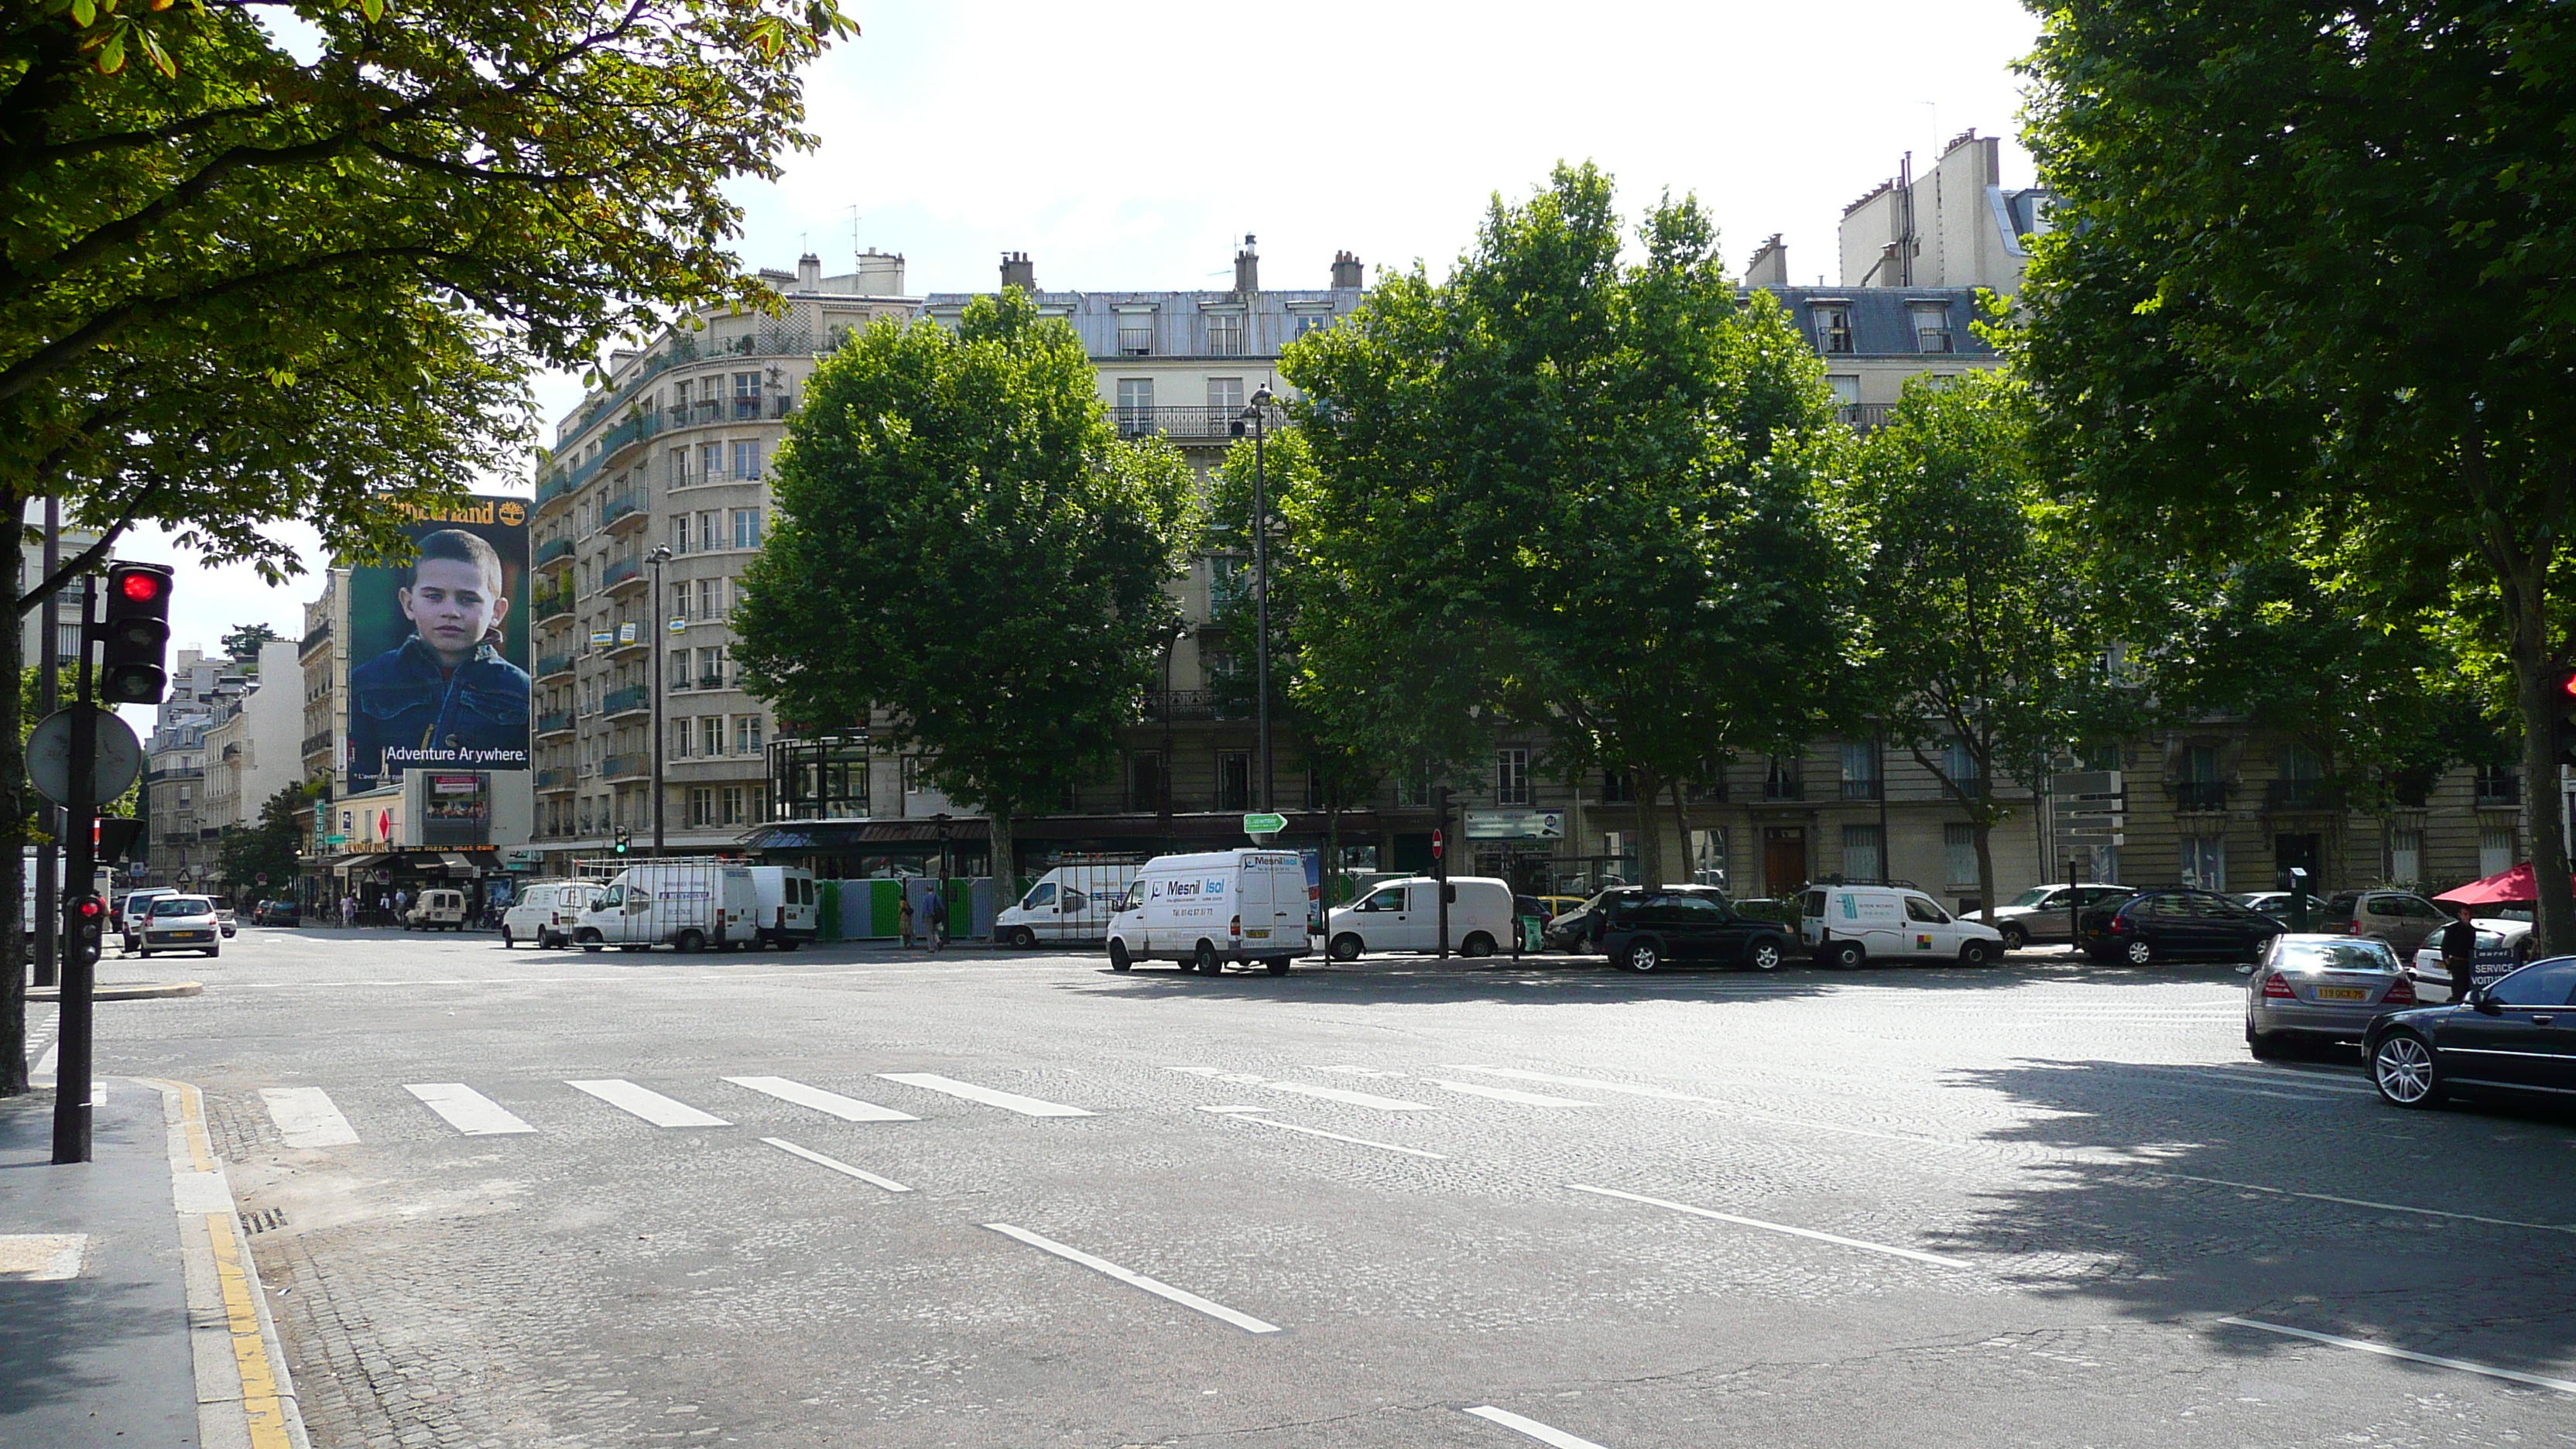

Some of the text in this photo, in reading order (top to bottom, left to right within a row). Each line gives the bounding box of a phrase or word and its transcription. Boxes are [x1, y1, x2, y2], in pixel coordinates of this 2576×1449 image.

[387, 746, 455, 760] Adventure
[1167, 879, 1225, 896] Mesnil Isol
[2475, 964, 2514, 973] SERVICE
[2353, 990, 2365, 999] 75
